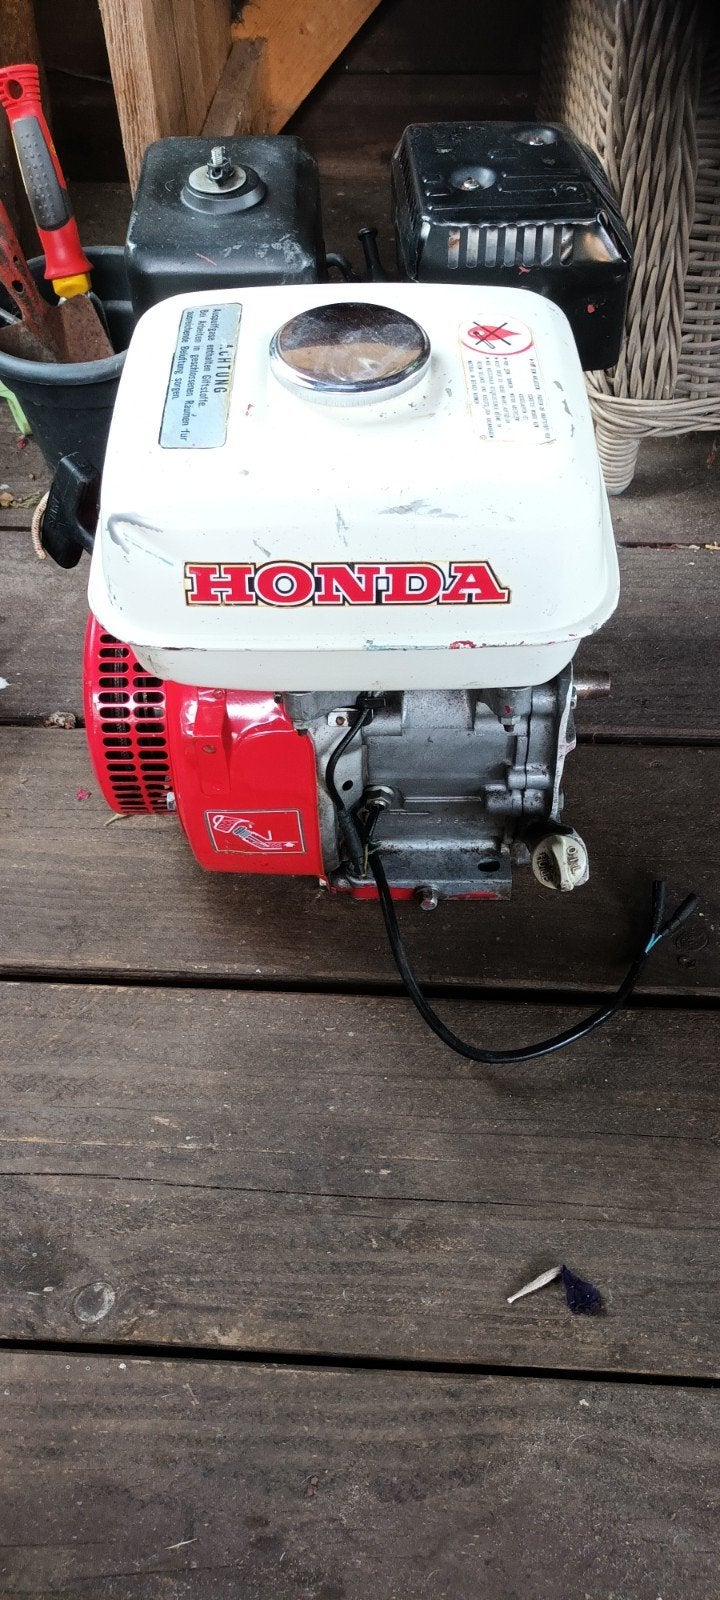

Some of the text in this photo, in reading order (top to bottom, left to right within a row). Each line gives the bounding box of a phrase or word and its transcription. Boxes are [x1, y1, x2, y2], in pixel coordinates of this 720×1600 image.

[199, 309, 209, 318] Bei
[207, 308, 221, 341] Auspuffgase
[195, 320, 206, 343] Arbeiten
[203, 344, 214, 372] enthalten
[186, 354, 199, 397] geschlossenen
[184, 560, 511, 607] HONDA
[566, 846, 581, 876] OIL
